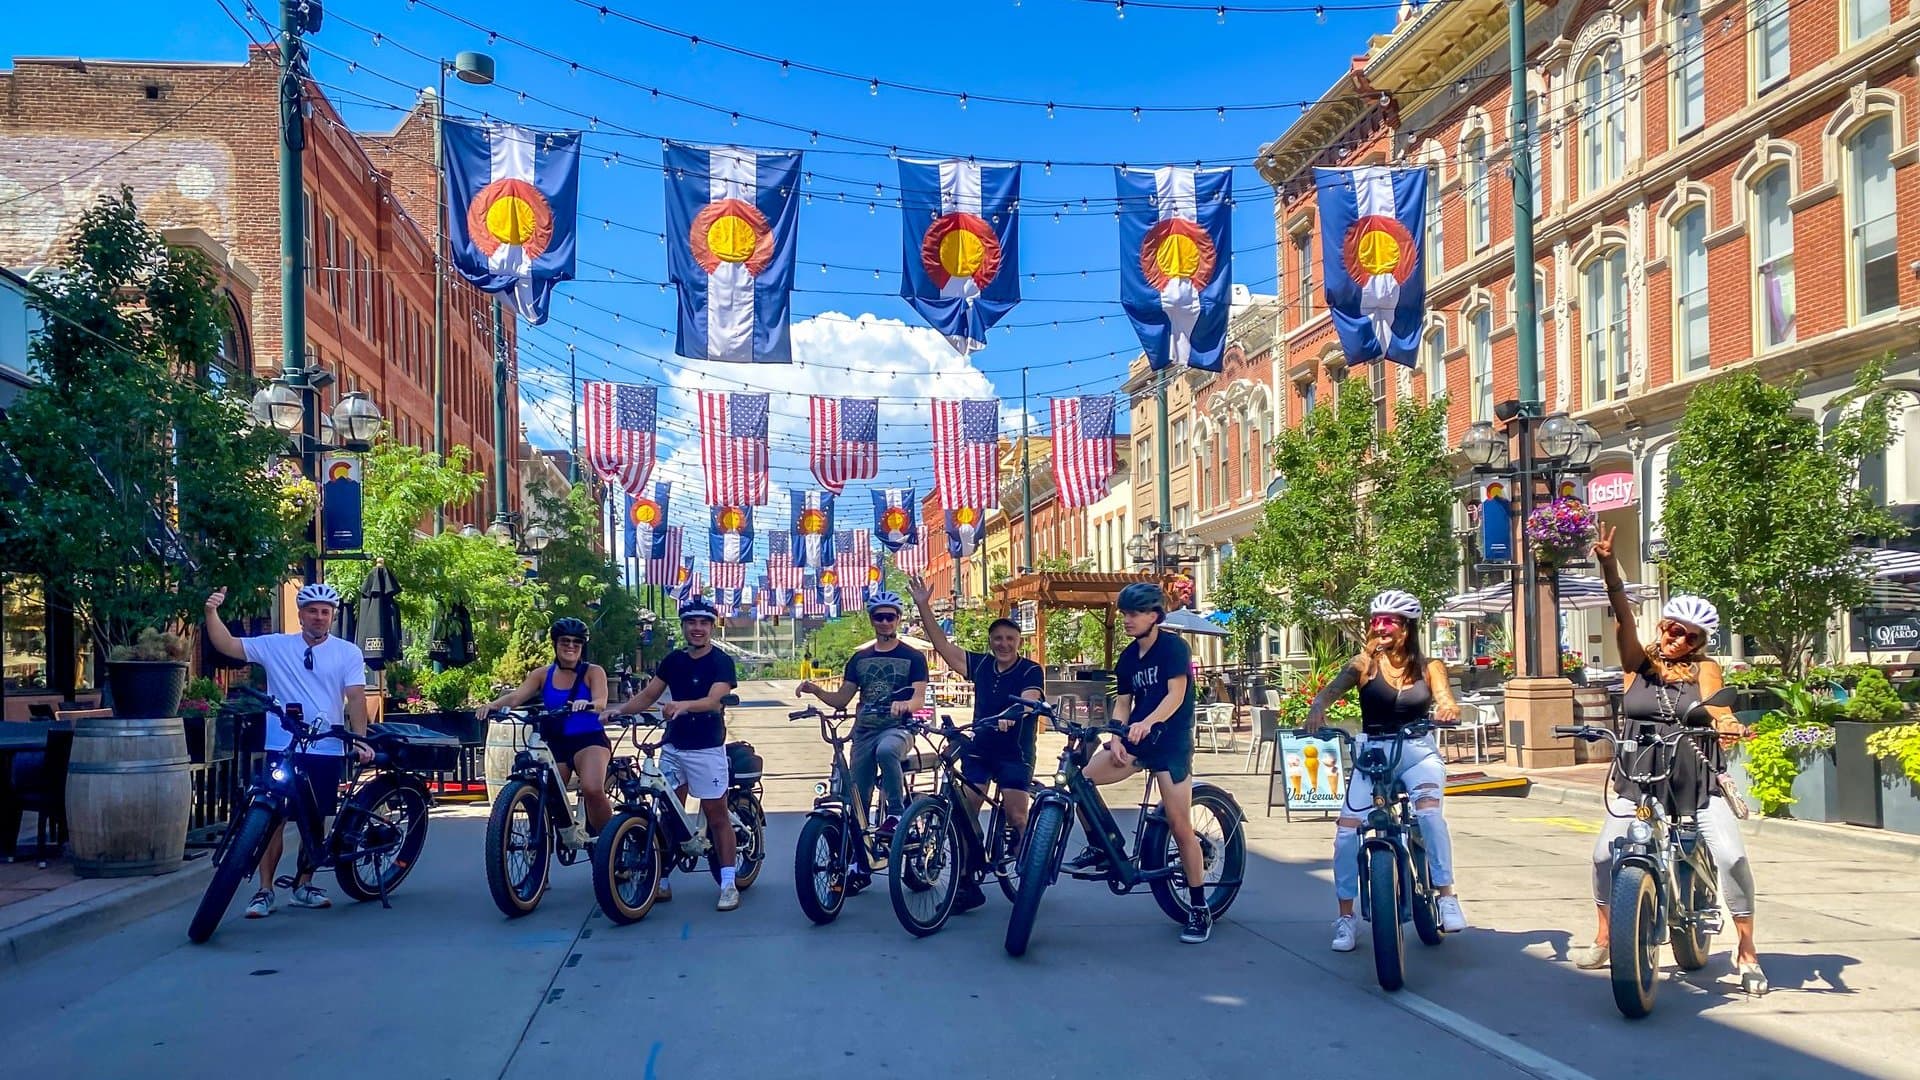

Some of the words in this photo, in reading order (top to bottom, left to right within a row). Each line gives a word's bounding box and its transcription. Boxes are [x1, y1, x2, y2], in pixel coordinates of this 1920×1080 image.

[1591, 477, 1633, 504] fastly
[1881, 629, 1919, 645] MARCO
[1287, 787, 1306, 801] Van
